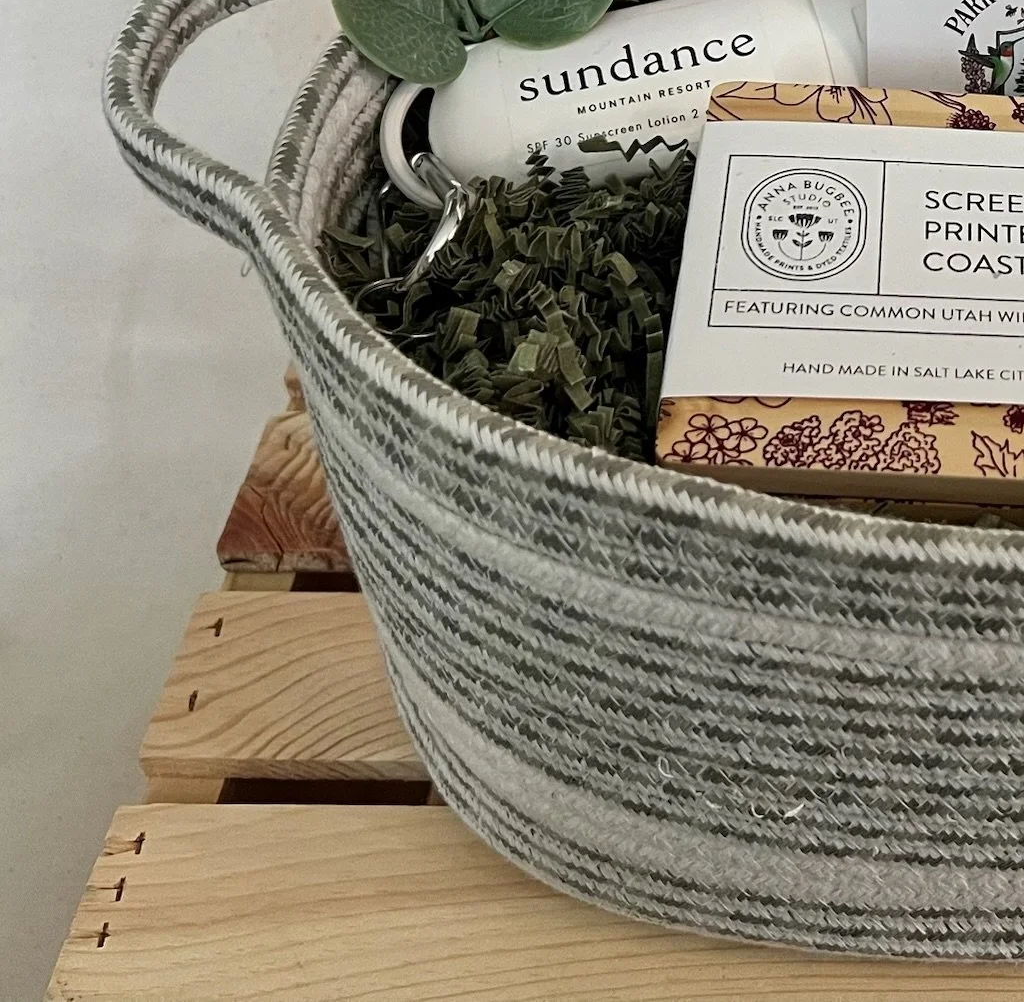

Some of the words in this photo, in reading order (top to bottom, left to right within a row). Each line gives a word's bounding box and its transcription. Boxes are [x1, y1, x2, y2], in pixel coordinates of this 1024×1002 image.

[518, 33, 756, 102] sundance
[576, 92, 652, 115] MOUNTAIN
[658, 79, 712, 98] RESORT
[527, 140, 549, 154] SPF
[555, 135, 572, 149] 30
[647, 112, 686, 129] Lotion
[691, 109, 699, 119] 2
[757, 182, 797, 212] ANNA
[803, 180, 855, 216] BUGBEE
[783, 193, 831, 208] STUDIO
[774, 259, 804, 271] PRINTS
[816, 255, 837, 269] DYED
[723, 300, 835, 318] FEATURING
[840, 304, 935, 321] COMMON
[941, 307, 992, 323] UTAH
[782, 362, 834, 376] HAND
[838, 364, 887, 378] MADE
[892, 366, 909, 378] IN
[914, 366, 950, 380] SALT
[955, 368, 995, 381] LAKE
